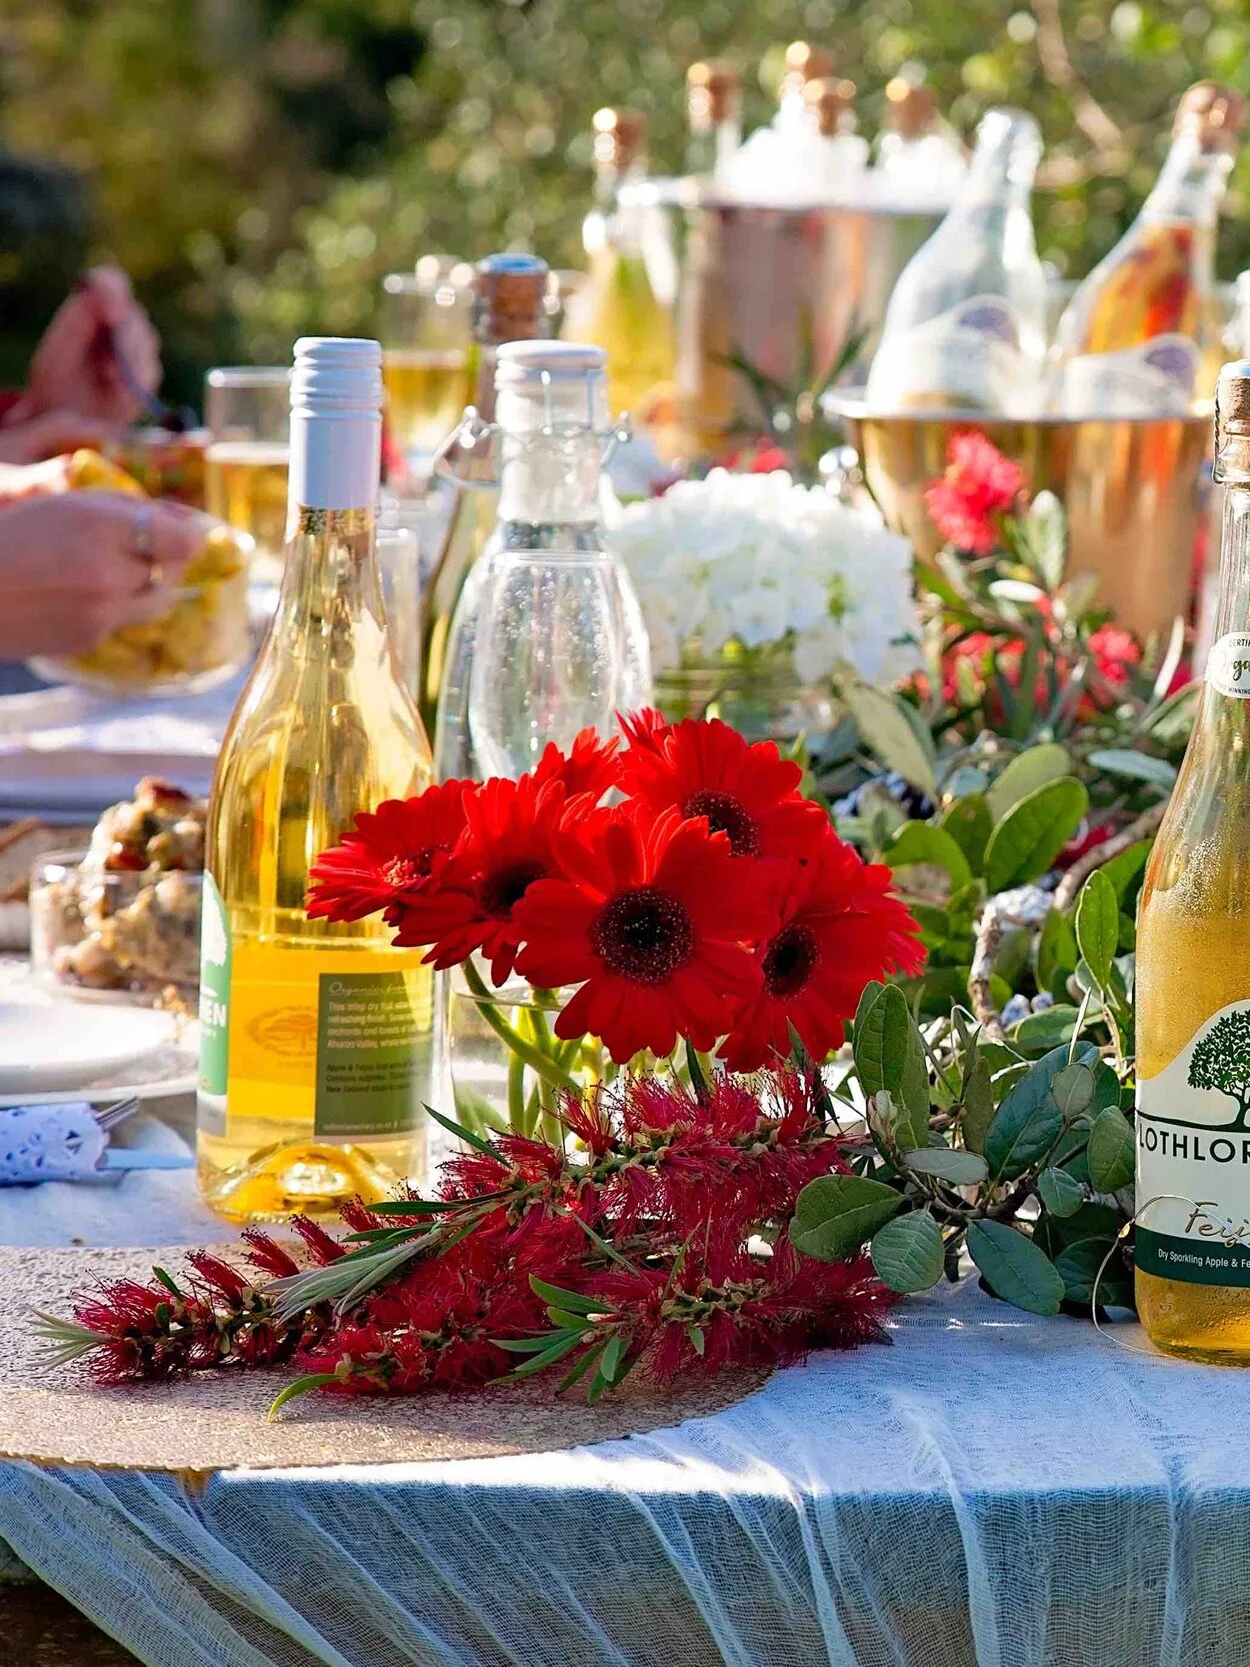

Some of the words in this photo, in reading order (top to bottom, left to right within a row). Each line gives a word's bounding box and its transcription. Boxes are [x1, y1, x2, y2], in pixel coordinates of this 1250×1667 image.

[1158, 1248, 1169, 1261] Dry
[1169, 1251, 1203, 1267] Sparkling
[1205, 1256, 1229, 1268] Apple
[1231, 1258, 1239, 1268] &
